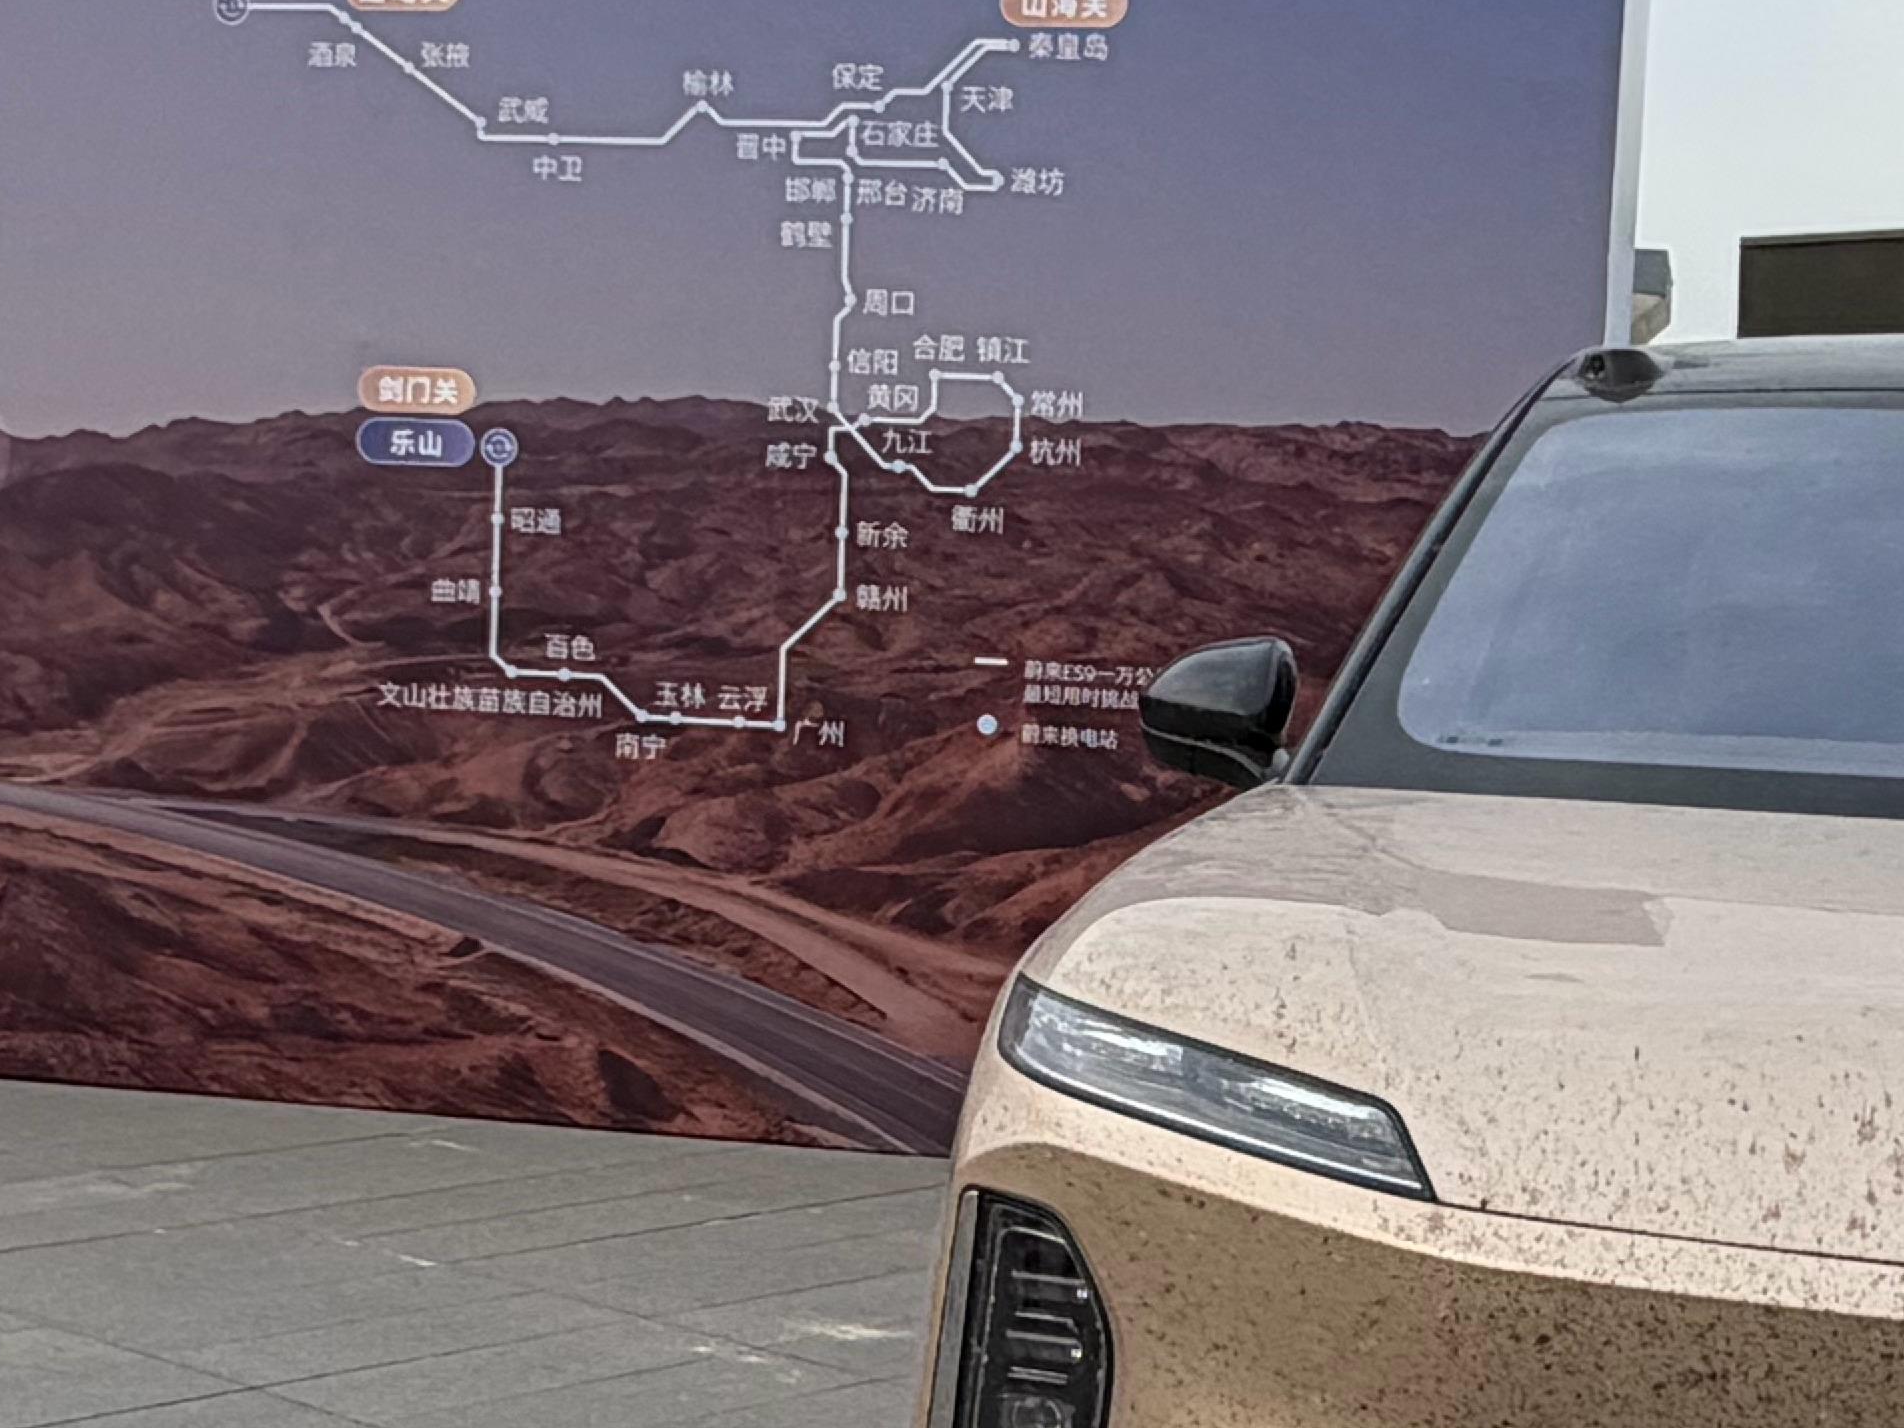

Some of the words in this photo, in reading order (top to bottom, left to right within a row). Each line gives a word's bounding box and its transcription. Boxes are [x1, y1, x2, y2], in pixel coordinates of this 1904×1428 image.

[308, 41, 357, 68] 酒泉
[420, 41, 470, 68] 张掖
[1028, 32, 1108, 62] 秦皇岛
[682, 69, 734, 96] 榆林
[832, 62, 884, 91] 保定
[498, 96, 549, 124] 武威
[960, 86, 1014, 114] 天津
[736, 133, 786, 161] 晋中
[860, 121, 939, 148] 石家庄
[532, 154, 582, 182] 中卫
[1010, 167, 1065, 196] 潍坊
[856, 178, 908, 206] 邢台
[911, 187, 964, 215] 济南
[862, 289, 915, 317] 周口
[846, 348, 899, 375] 信阳
[912, 334, 966, 362] 合肥
[976, 336, 1030, 364] 镇江
[378, 376, 458, 405] 剑门关
[868, 384, 919, 411] 黄冈
[1030, 390, 1084, 419] 常州
[766, 396, 822, 424] 武汉
[390, 428, 442, 458] 乐山
[881, 428, 933, 454] 九江
[1029, 437, 1082, 467] 杭州
[764, 442, 818, 470] 咸宁
[510, 507, 561, 535] 昭通
[951, 505, 1004, 534] 衢州
[856, 521, 909, 550] 新余
[431, 578, 480, 604] 曲靖
[856, 584, 908, 612] 赣州
[545, 634, 596, 662] 百色
[1024, 659, 1164, 688] 蔚来ES9一万公
[376, 681, 602, 718] 文山壮族苗族自治州
[654, 682, 706, 710] 玉林
[717, 685, 768, 712] 云浮
[615, 733, 666, 760] 南宁
[792, 719, 845, 748] 广州
[1021, 723, 1119, 750] 蔚来换电站
